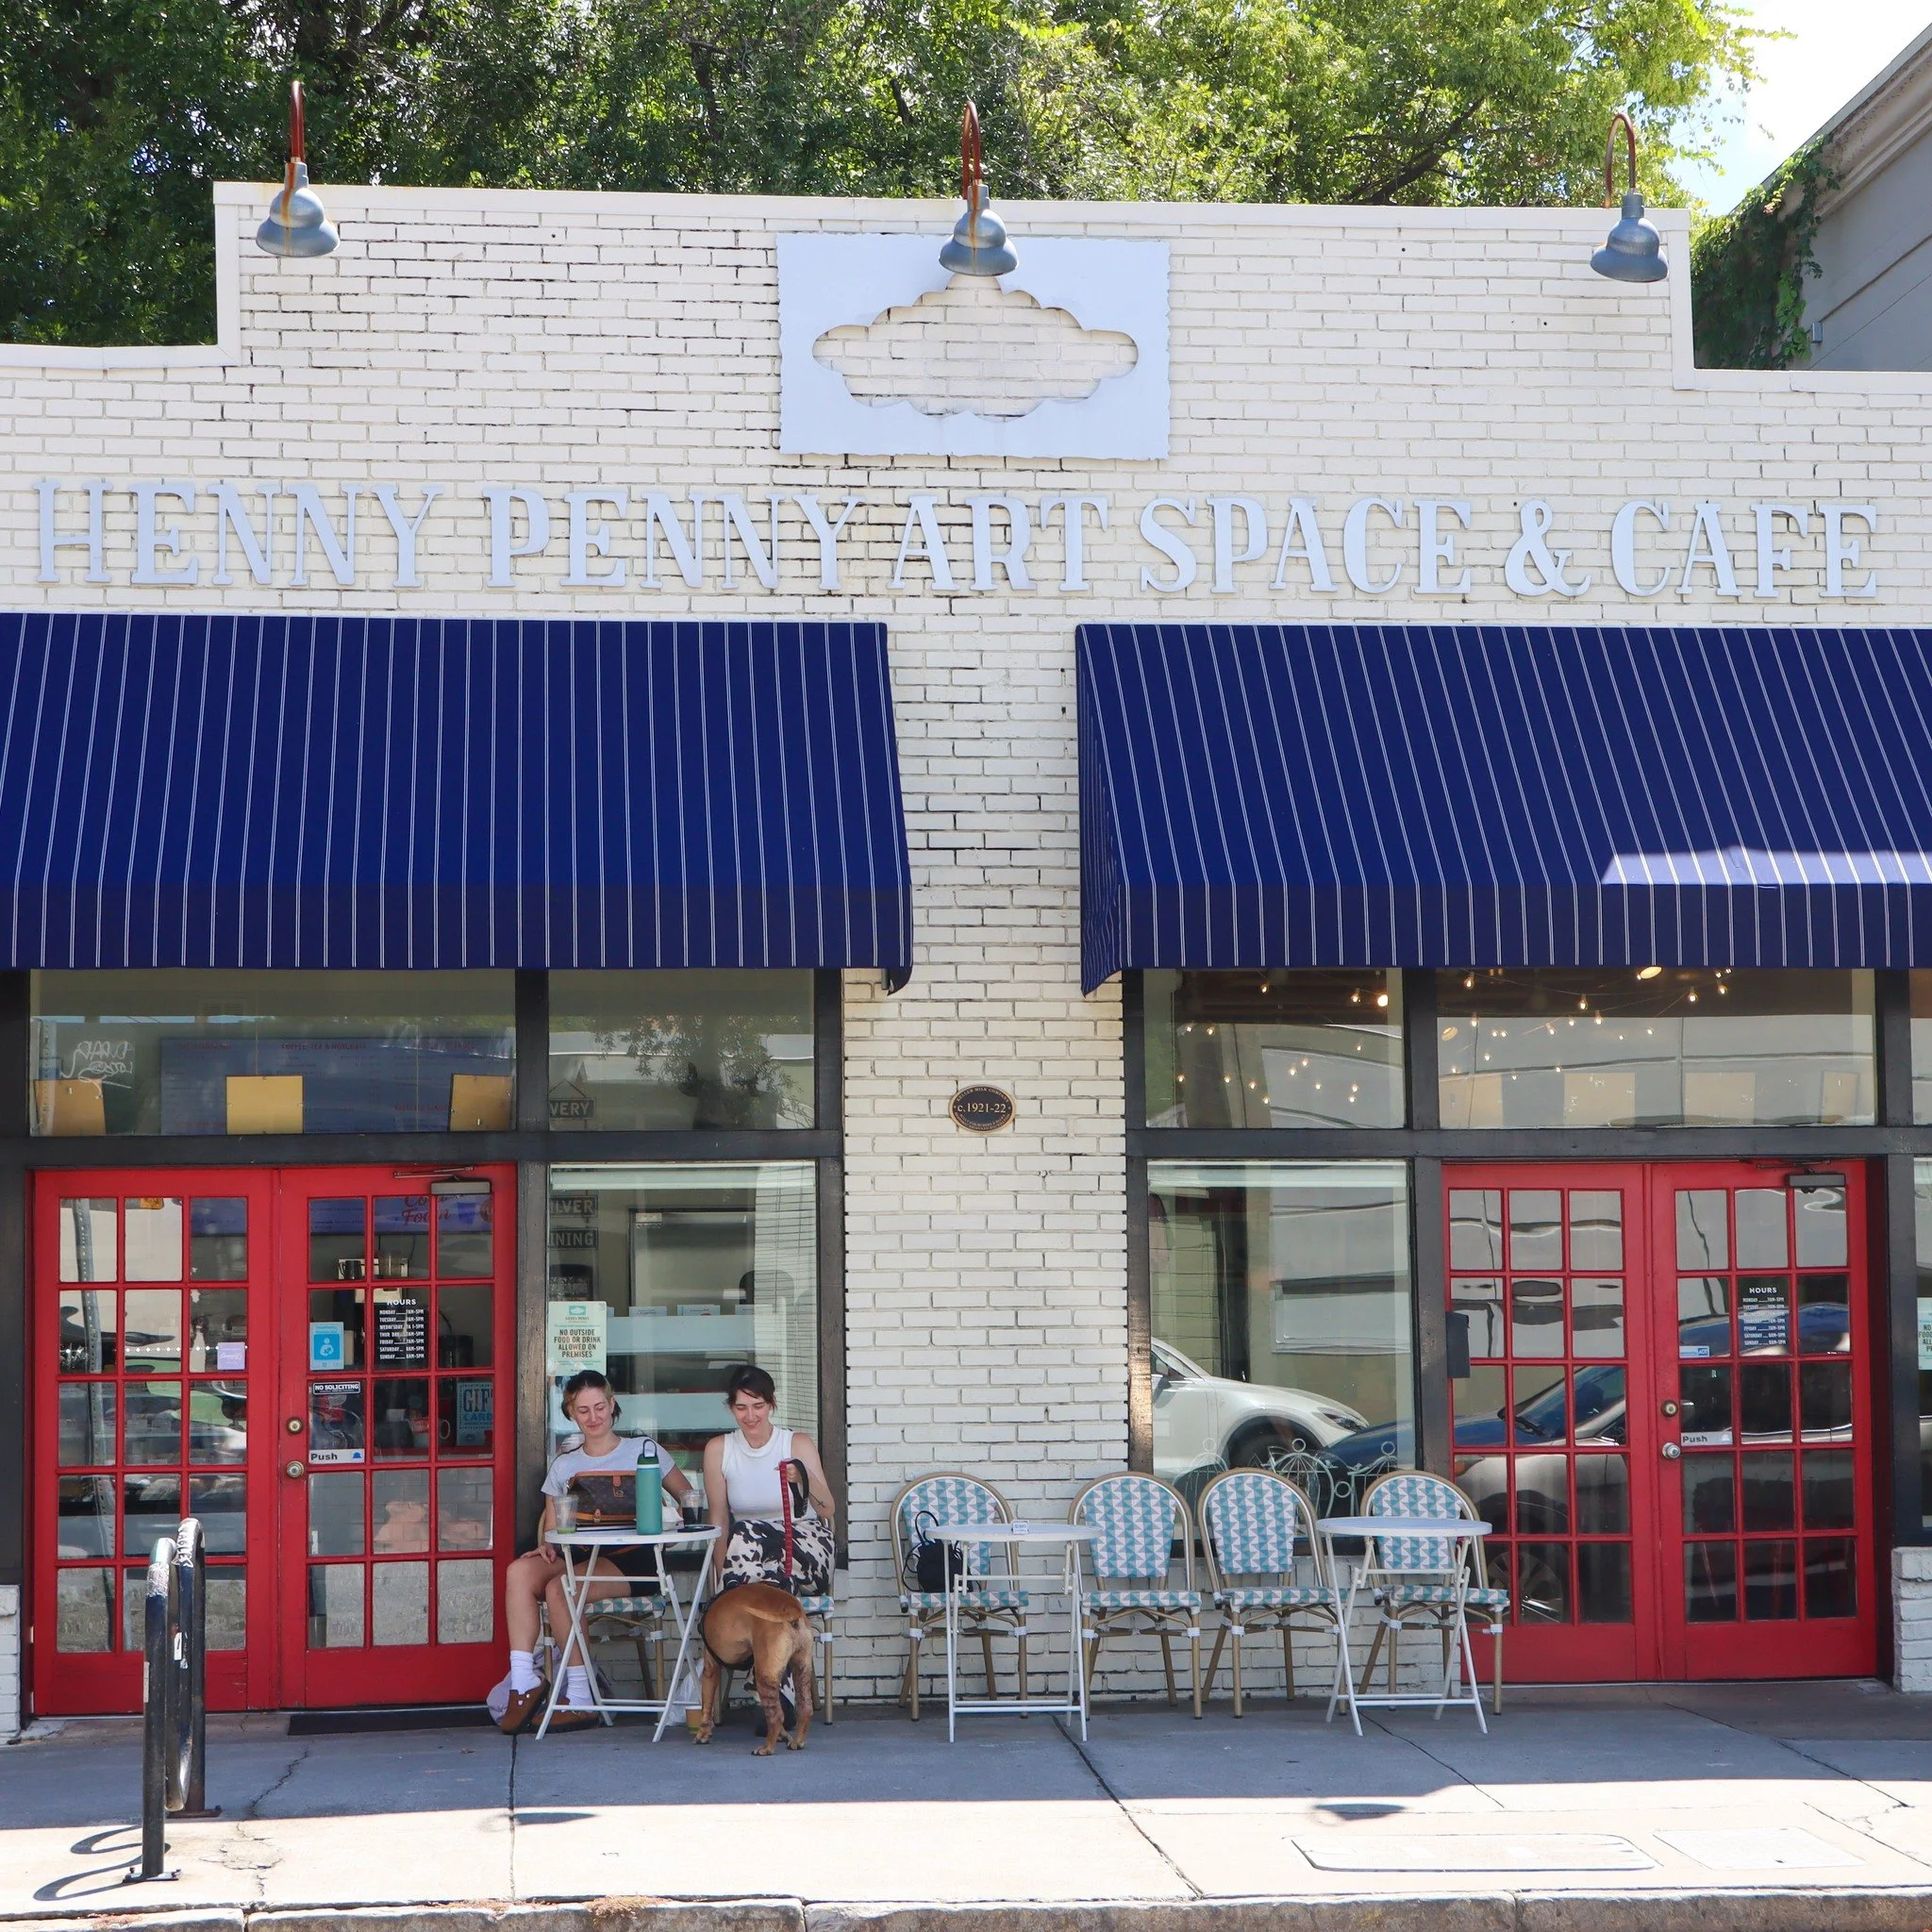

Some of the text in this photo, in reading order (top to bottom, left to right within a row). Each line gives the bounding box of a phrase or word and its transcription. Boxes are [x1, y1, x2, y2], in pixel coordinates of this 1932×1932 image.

[32, 479, 1877, 598] HENNY PENNY ART SPACE & CAFE
[957, 1103, 1007, 1113] c.1921-22
[463, 1389, 493, 1412] GIF
[1682, 1435, 1707, 1443] Push
[310, 1452, 338, 1461] Push
